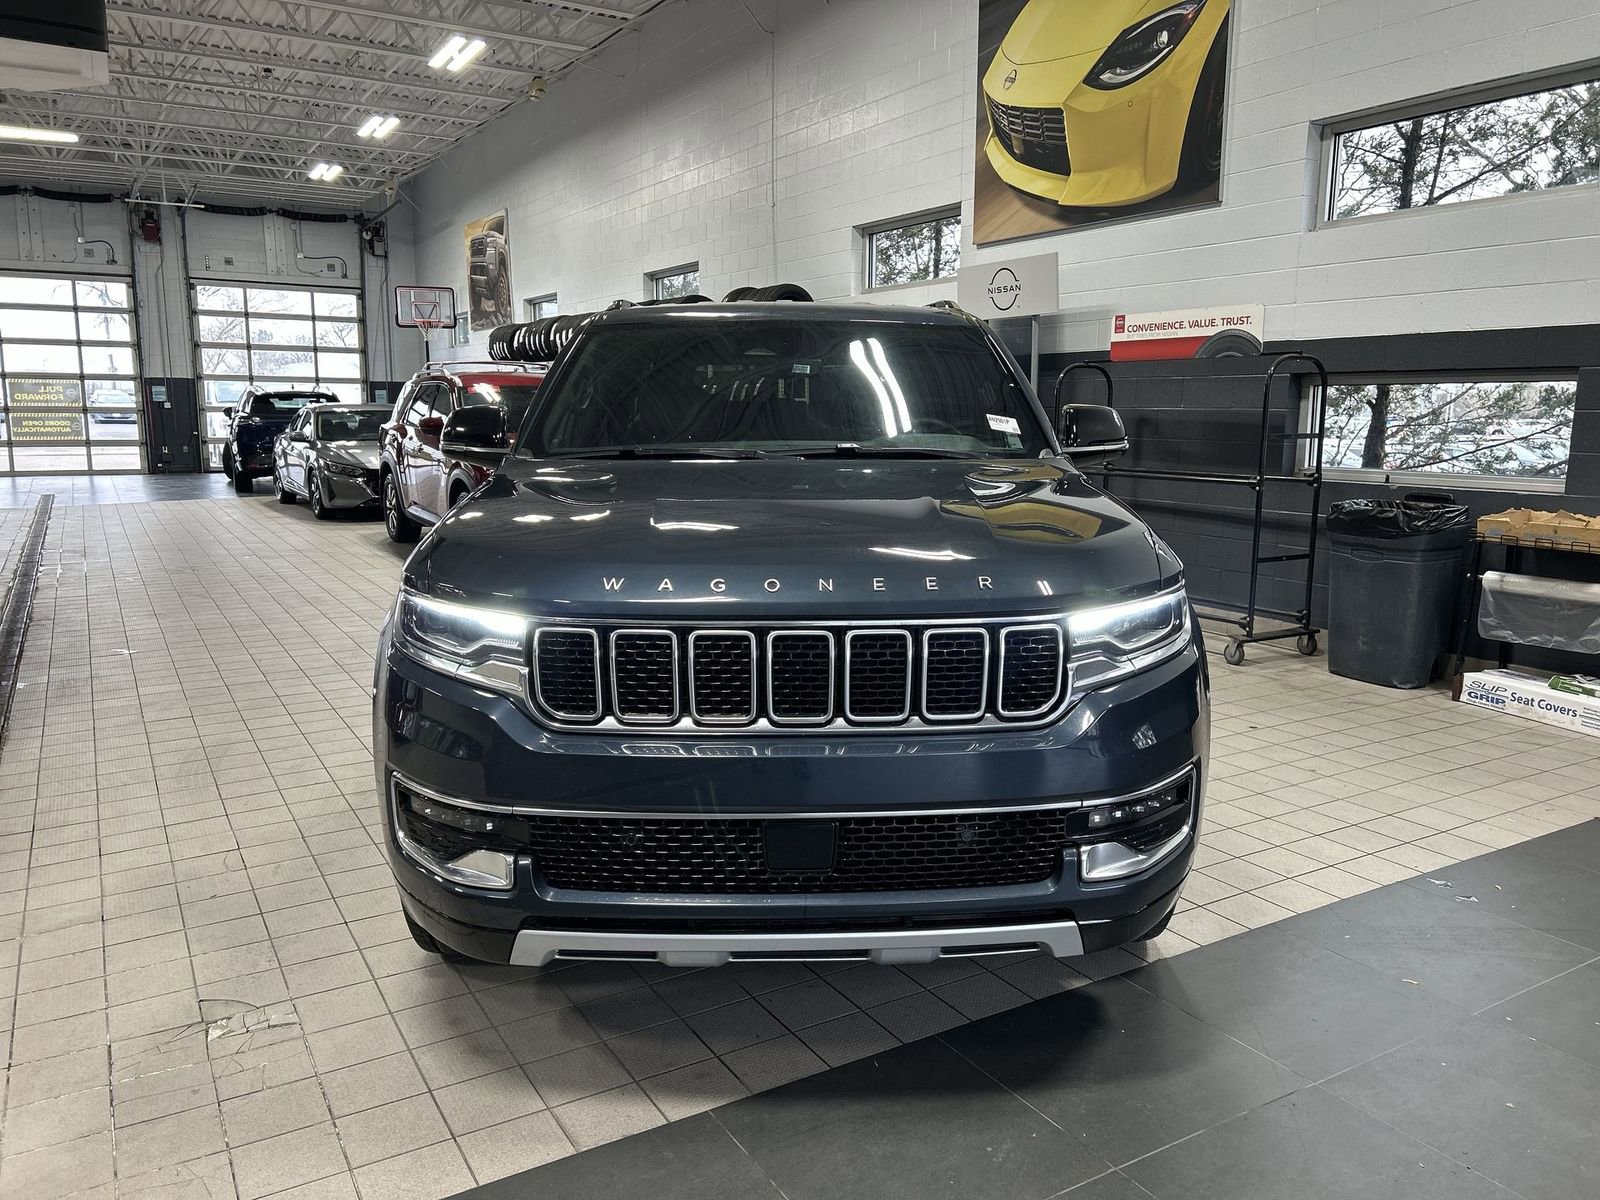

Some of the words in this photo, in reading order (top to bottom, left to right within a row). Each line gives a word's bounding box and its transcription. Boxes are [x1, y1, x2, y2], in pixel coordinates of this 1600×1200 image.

[988, 284, 1021, 294] NISSAN
[1127, 321, 1186, 333] CONVENIENCE.
[1188, 318, 1218, 328] VALUE.
[1221, 315, 1252, 326] TRUST.
[602, 575, 993, 593] WAGONEER
[1469, 680, 1507, 693] SLIP
[1467, 691, 1506, 704] GRIP
[1510, 692, 1535, 707] Seat
[1537, 699, 1578, 718] Covers
